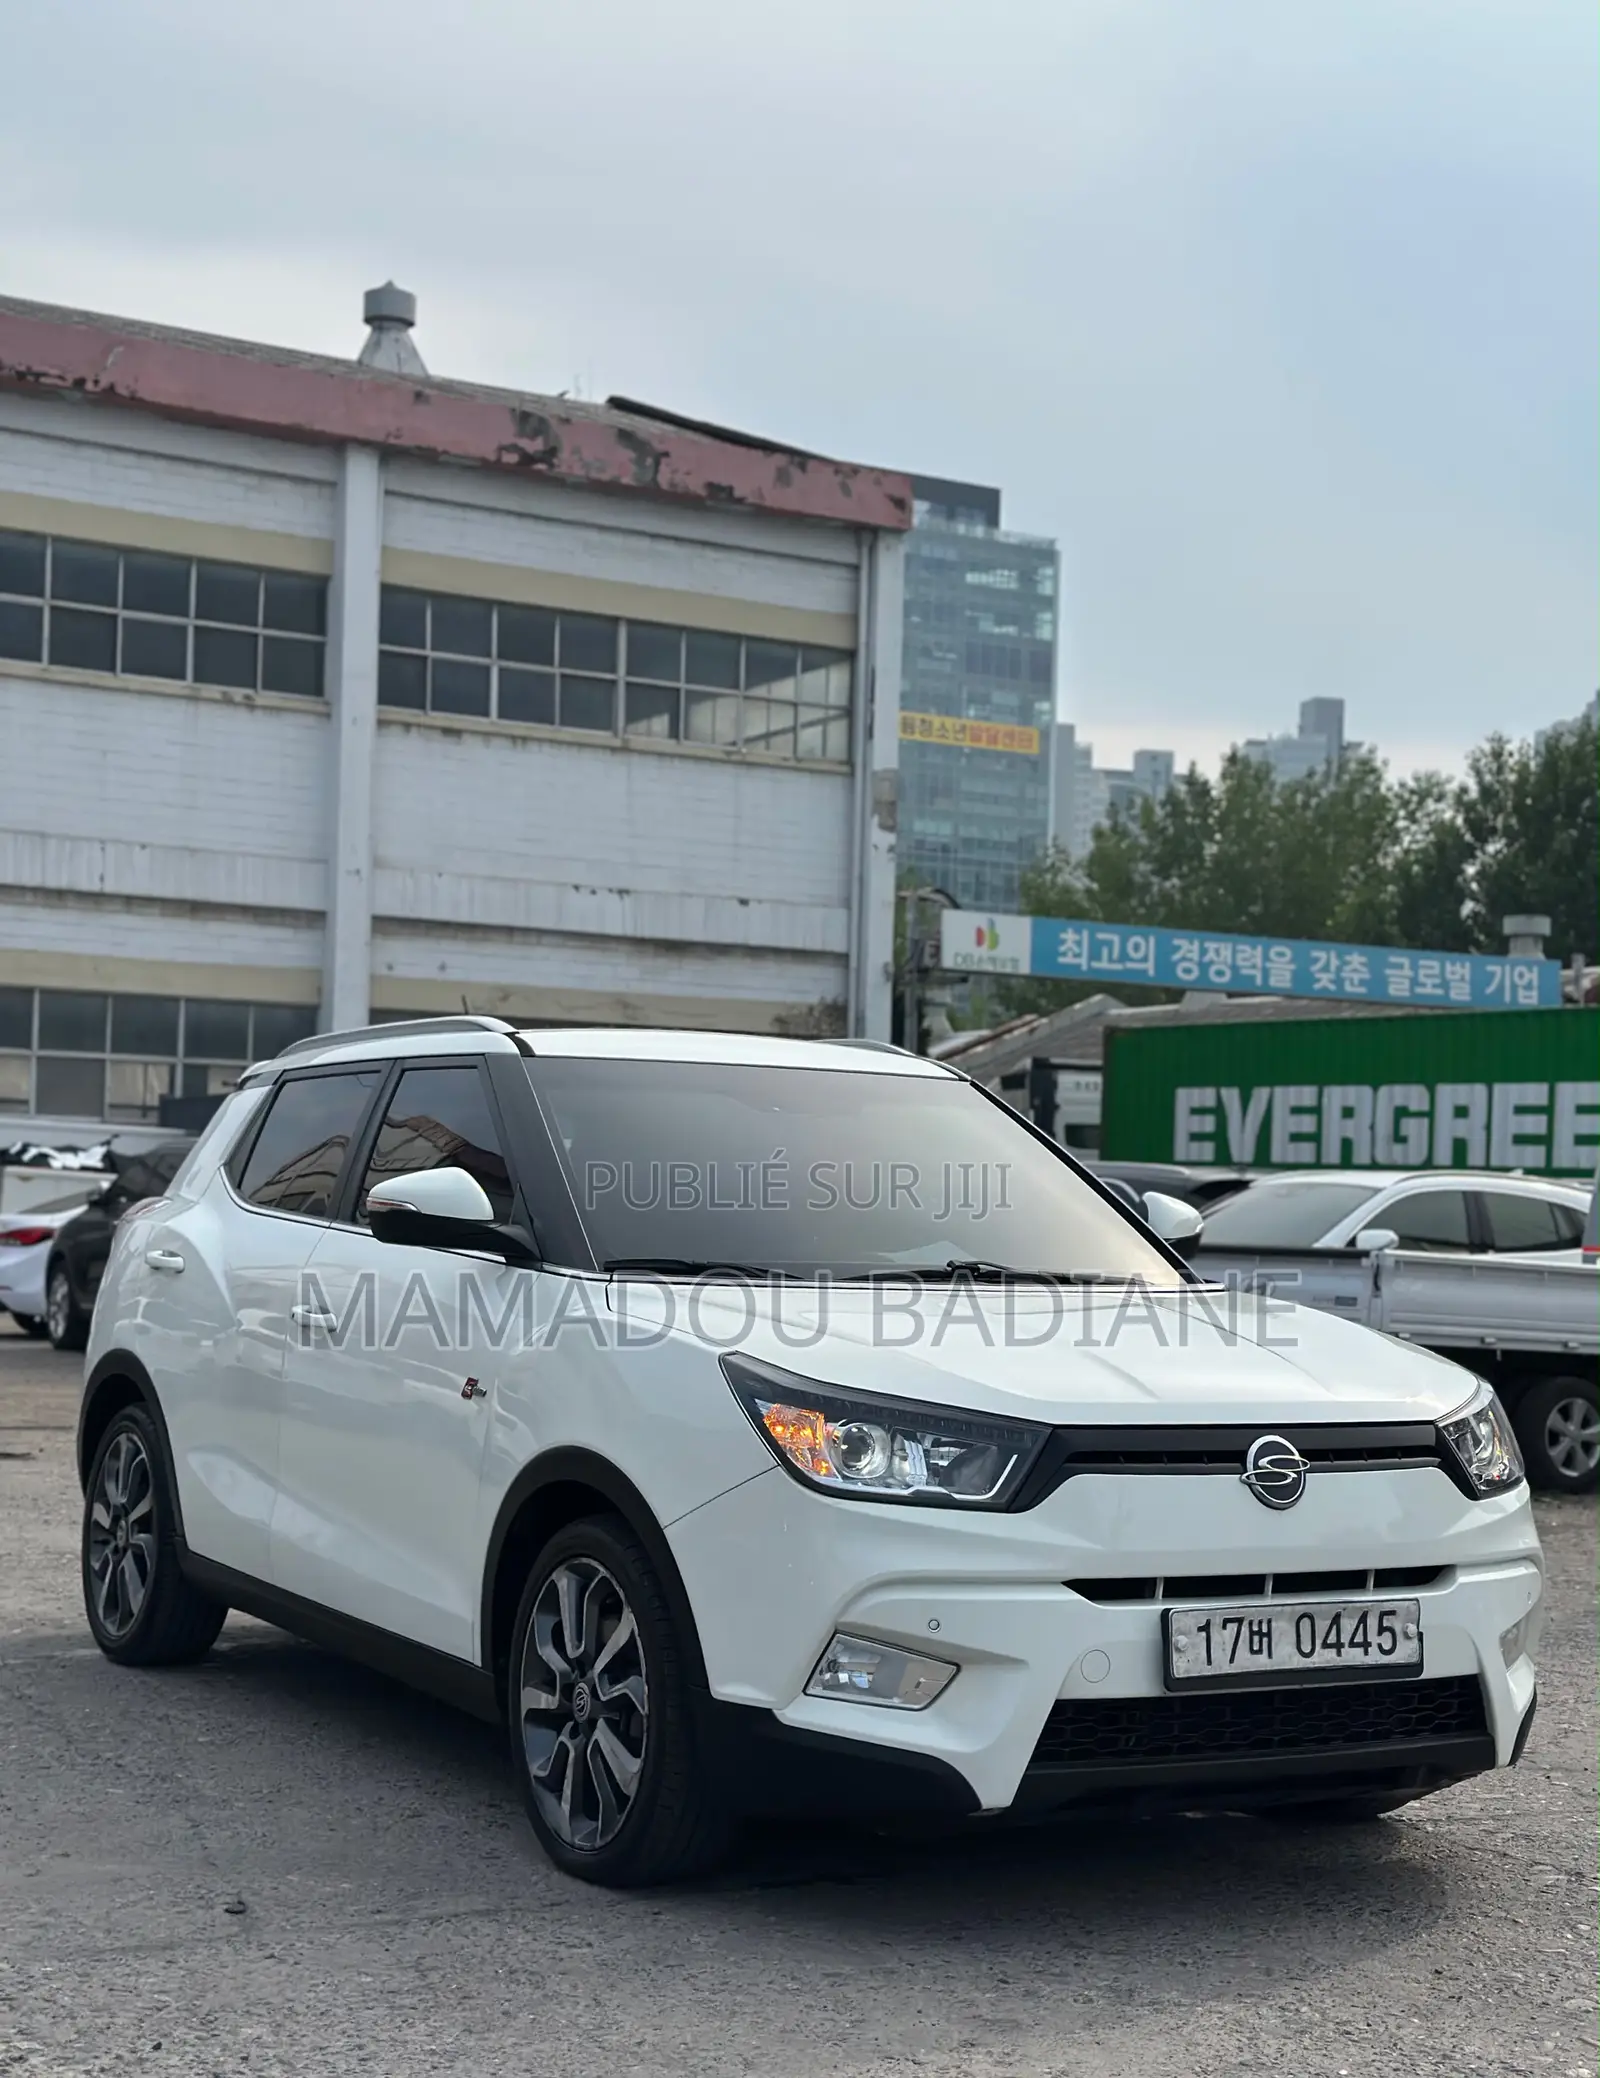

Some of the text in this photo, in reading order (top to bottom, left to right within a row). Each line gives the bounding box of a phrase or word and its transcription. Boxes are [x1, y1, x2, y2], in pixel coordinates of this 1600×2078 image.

[1057, 928, 1155, 976] 최고의
[1171, 938, 1296, 988] 경쟁력을
[1310, 950, 1371, 994] 갖춘
[1384, 956, 1472, 1001] 글로벌
[1484, 964, 1538, 1005] 기업
[1174, 1082, 1600, 1168] EVERGREE
[1196, 1609, 1398, 1666] 17버 0445
